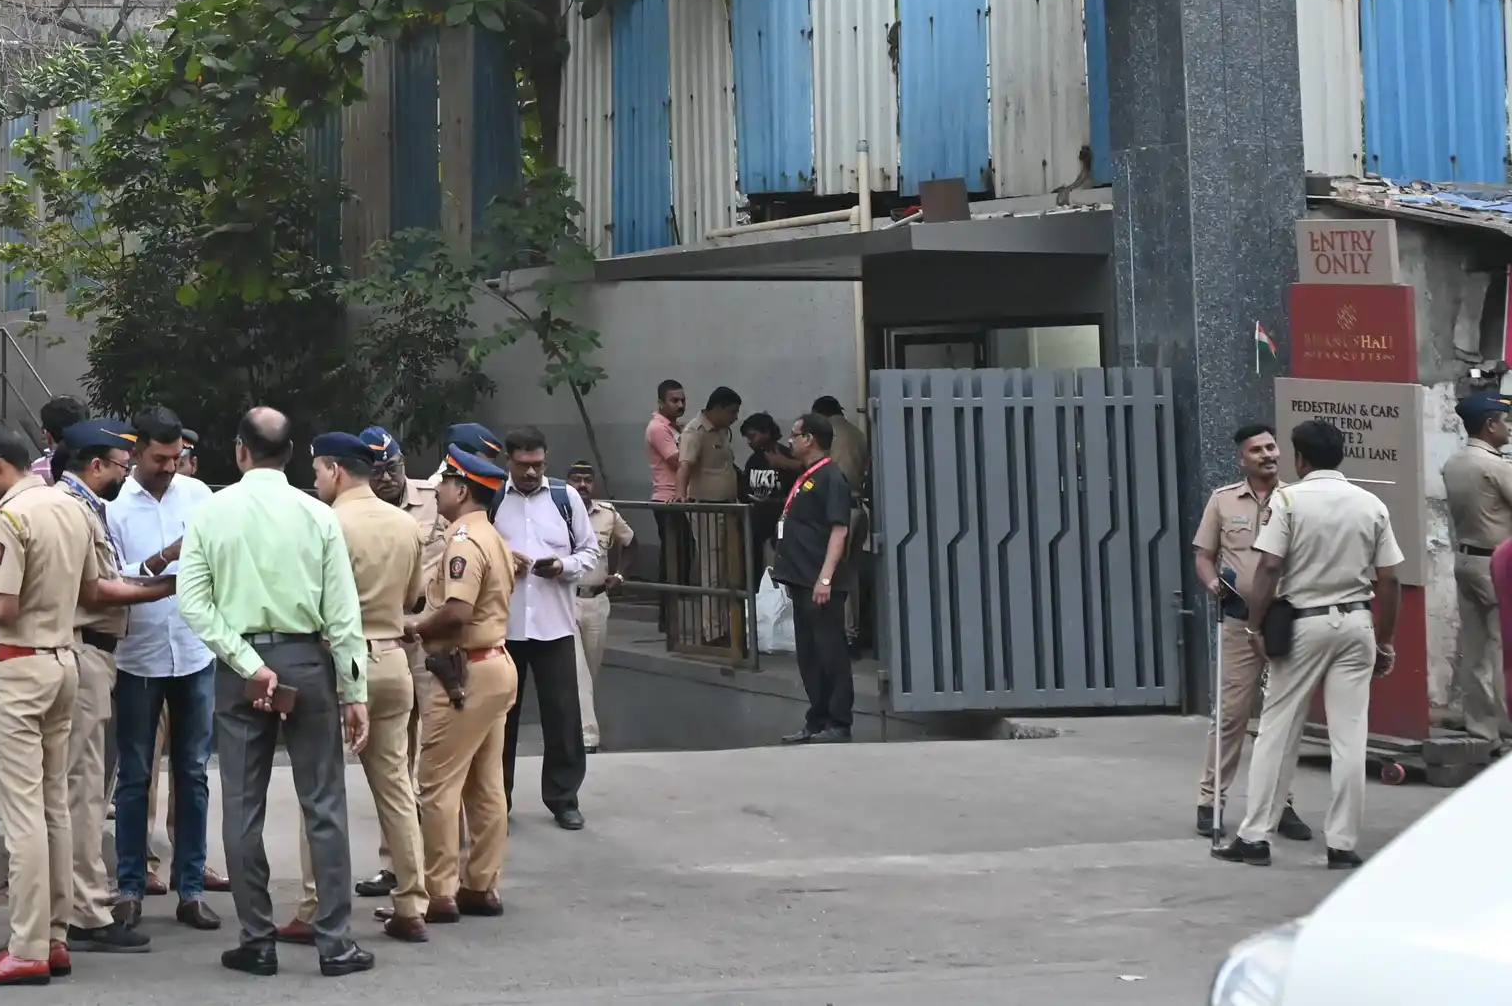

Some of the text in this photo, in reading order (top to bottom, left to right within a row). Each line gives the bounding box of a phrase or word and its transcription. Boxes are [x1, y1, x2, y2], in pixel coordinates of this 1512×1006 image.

[1308, 230, 1376, 252] ENTRY
[1314, 253, 1373, 274] ONLY
[1291, 400, 1400, 419] PEDESTRIAN & CARS
[1340, 418, 1373, 431] FROM
[1357, 432, 1363, 444] 2
[1369, 447, 1398, 461] LANE
